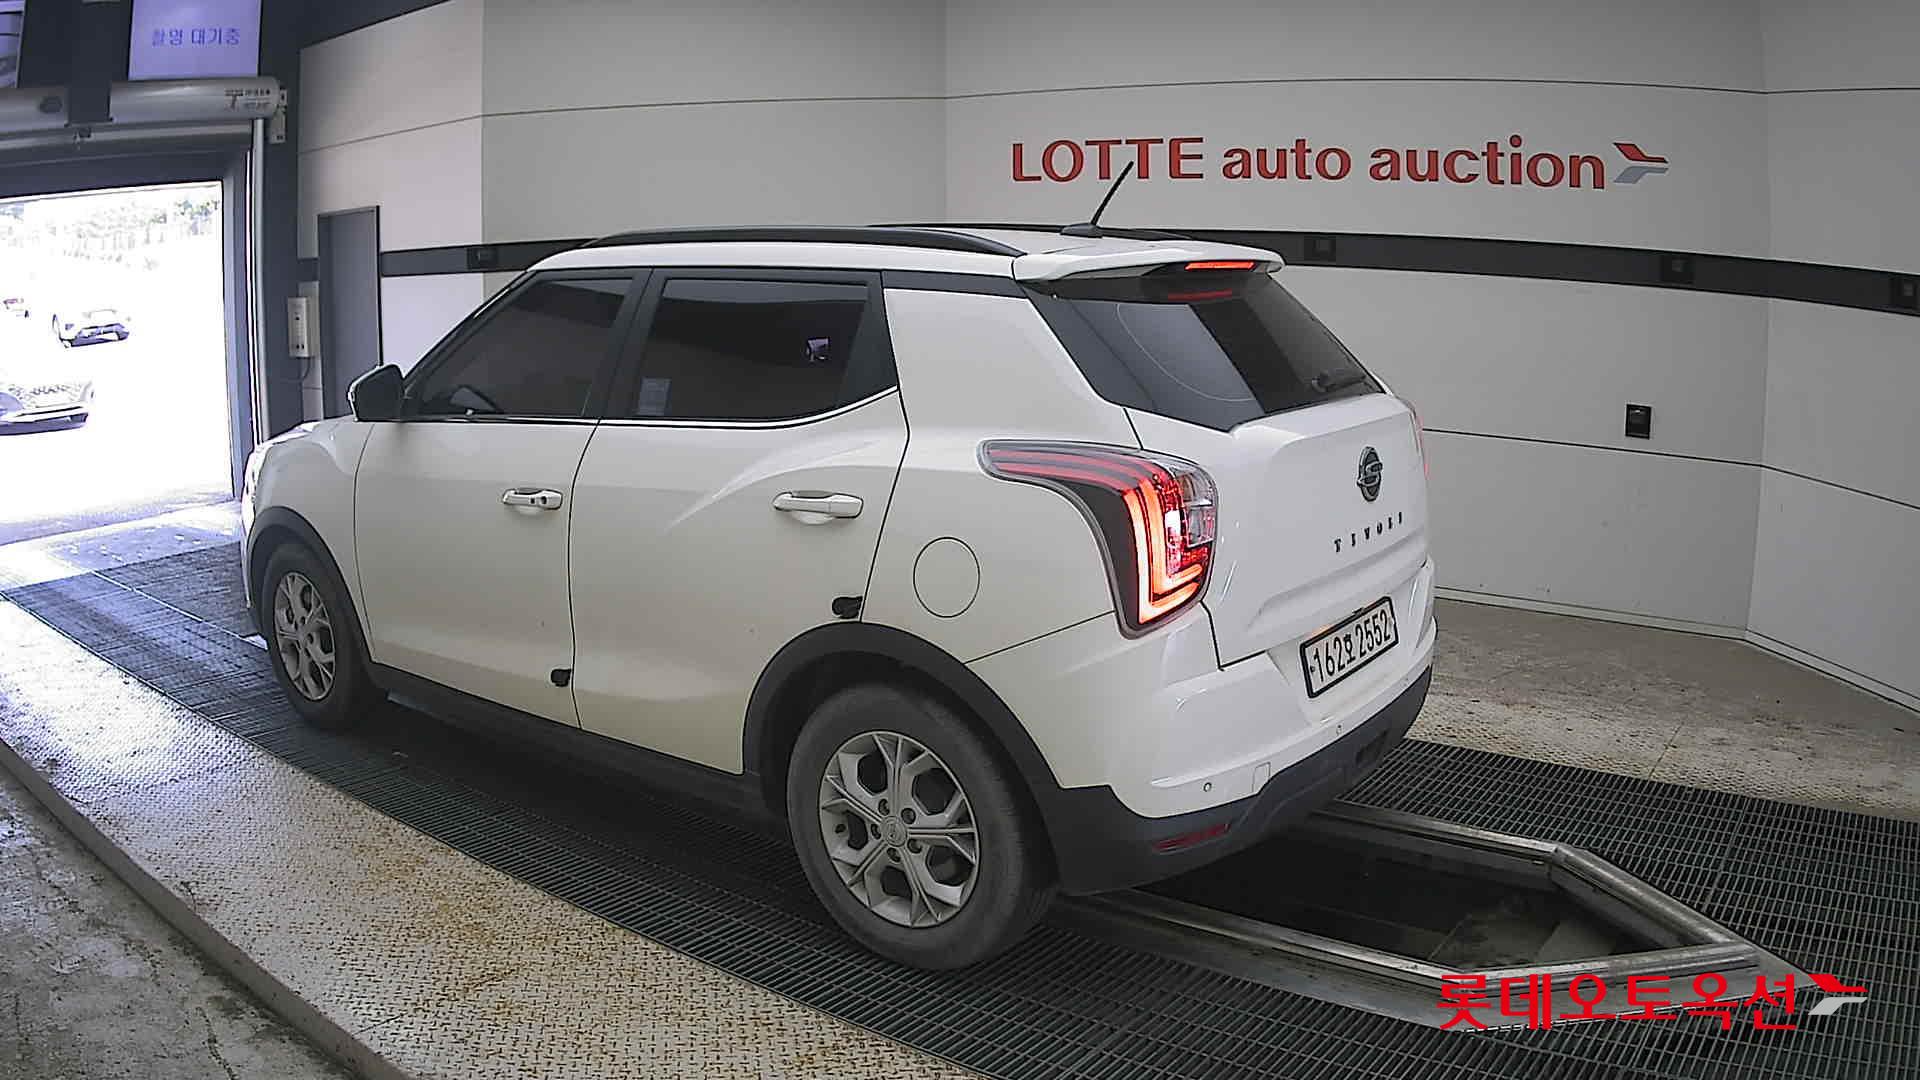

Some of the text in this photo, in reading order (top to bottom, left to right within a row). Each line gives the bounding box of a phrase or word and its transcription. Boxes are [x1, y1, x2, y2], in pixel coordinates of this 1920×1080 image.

[191, 27, 240, 46] 대기중
[1012, 135, 1606, 189] LOTTE auto auction
[1334, 511, 1403, 553] TIVOLI
[1355, 609, 1391, 658] 2552
